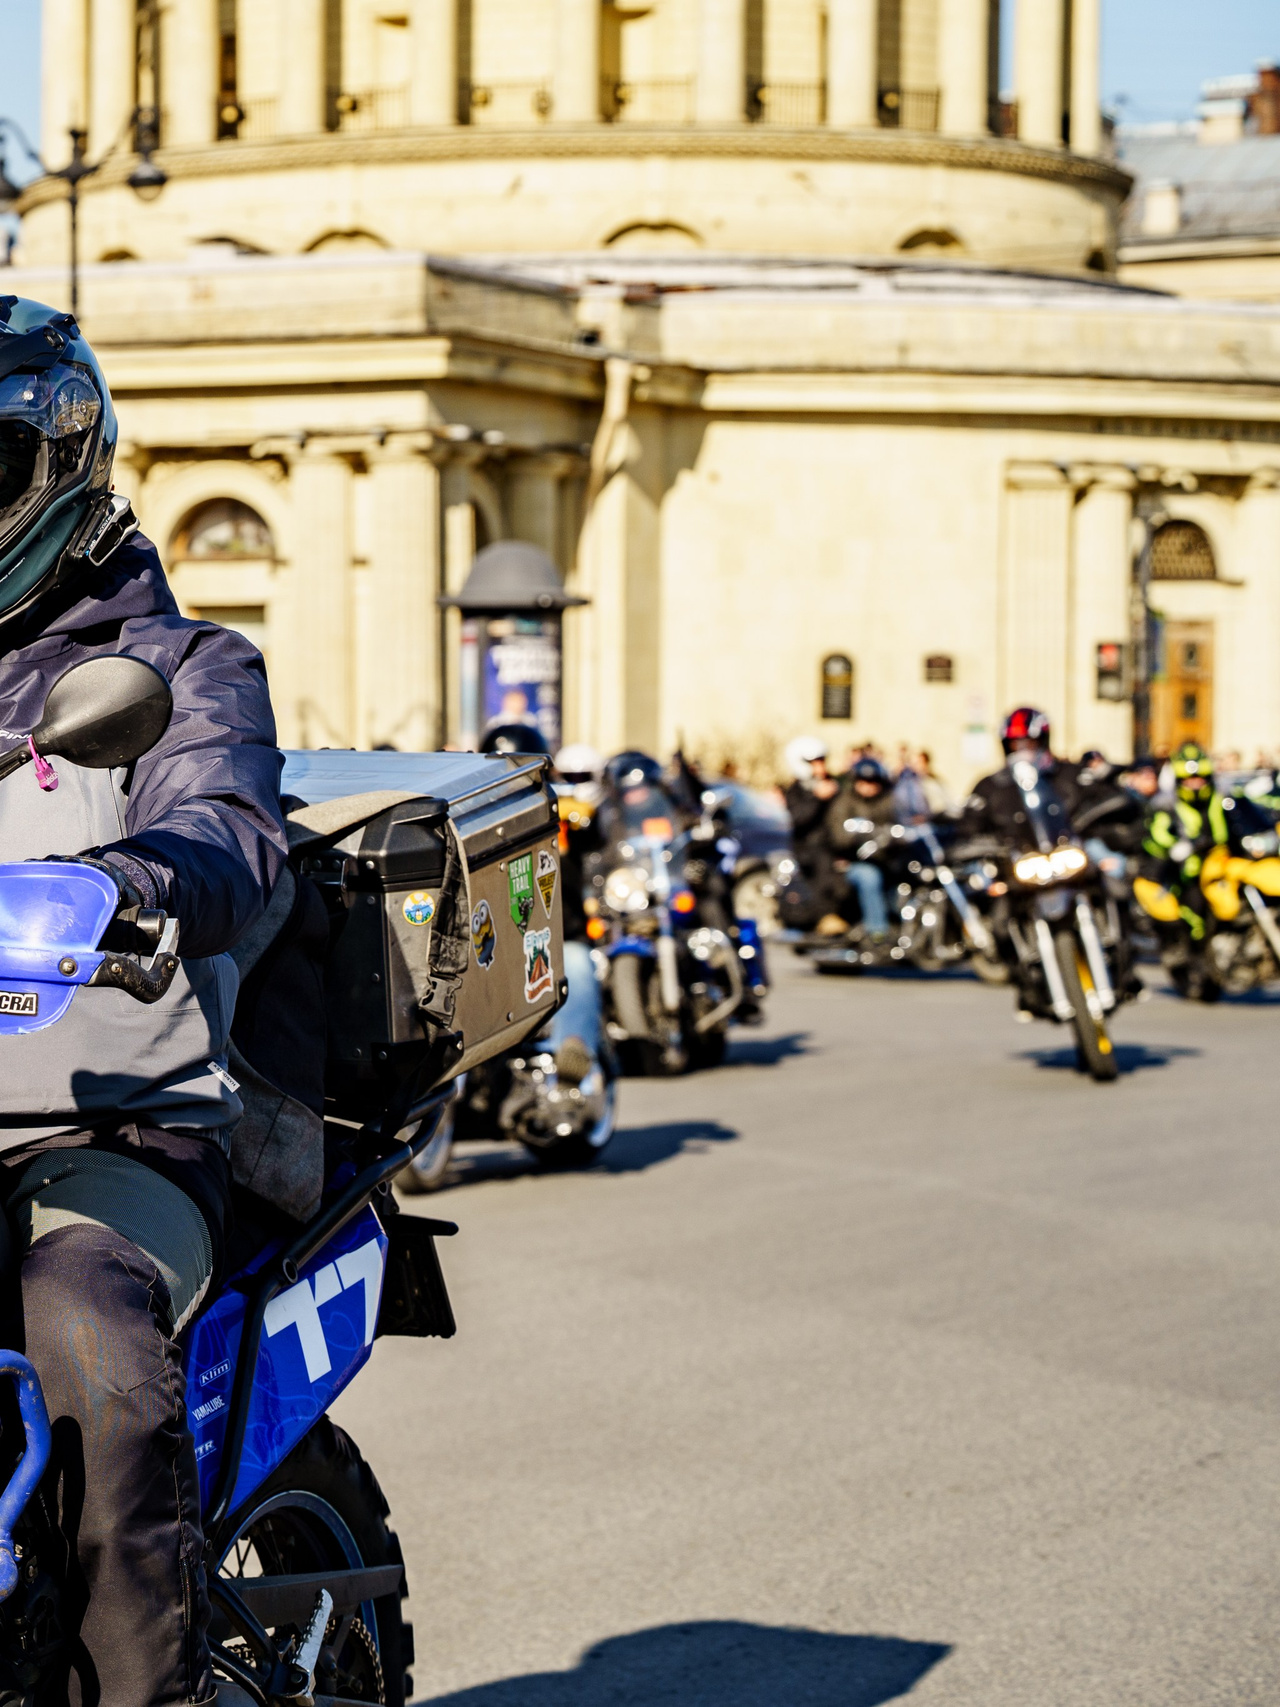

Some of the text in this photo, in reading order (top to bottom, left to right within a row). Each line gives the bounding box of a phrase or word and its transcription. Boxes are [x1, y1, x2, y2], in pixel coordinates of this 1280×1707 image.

[509, 854, 531, 878] HEAVY
[512, 873, 530, 895] TRAIL
[263, 1238, 383, 1384] T7
[201, 1362, 229, 1384] Klim
[192, 1395, 225, 1421] YAMALUBE
